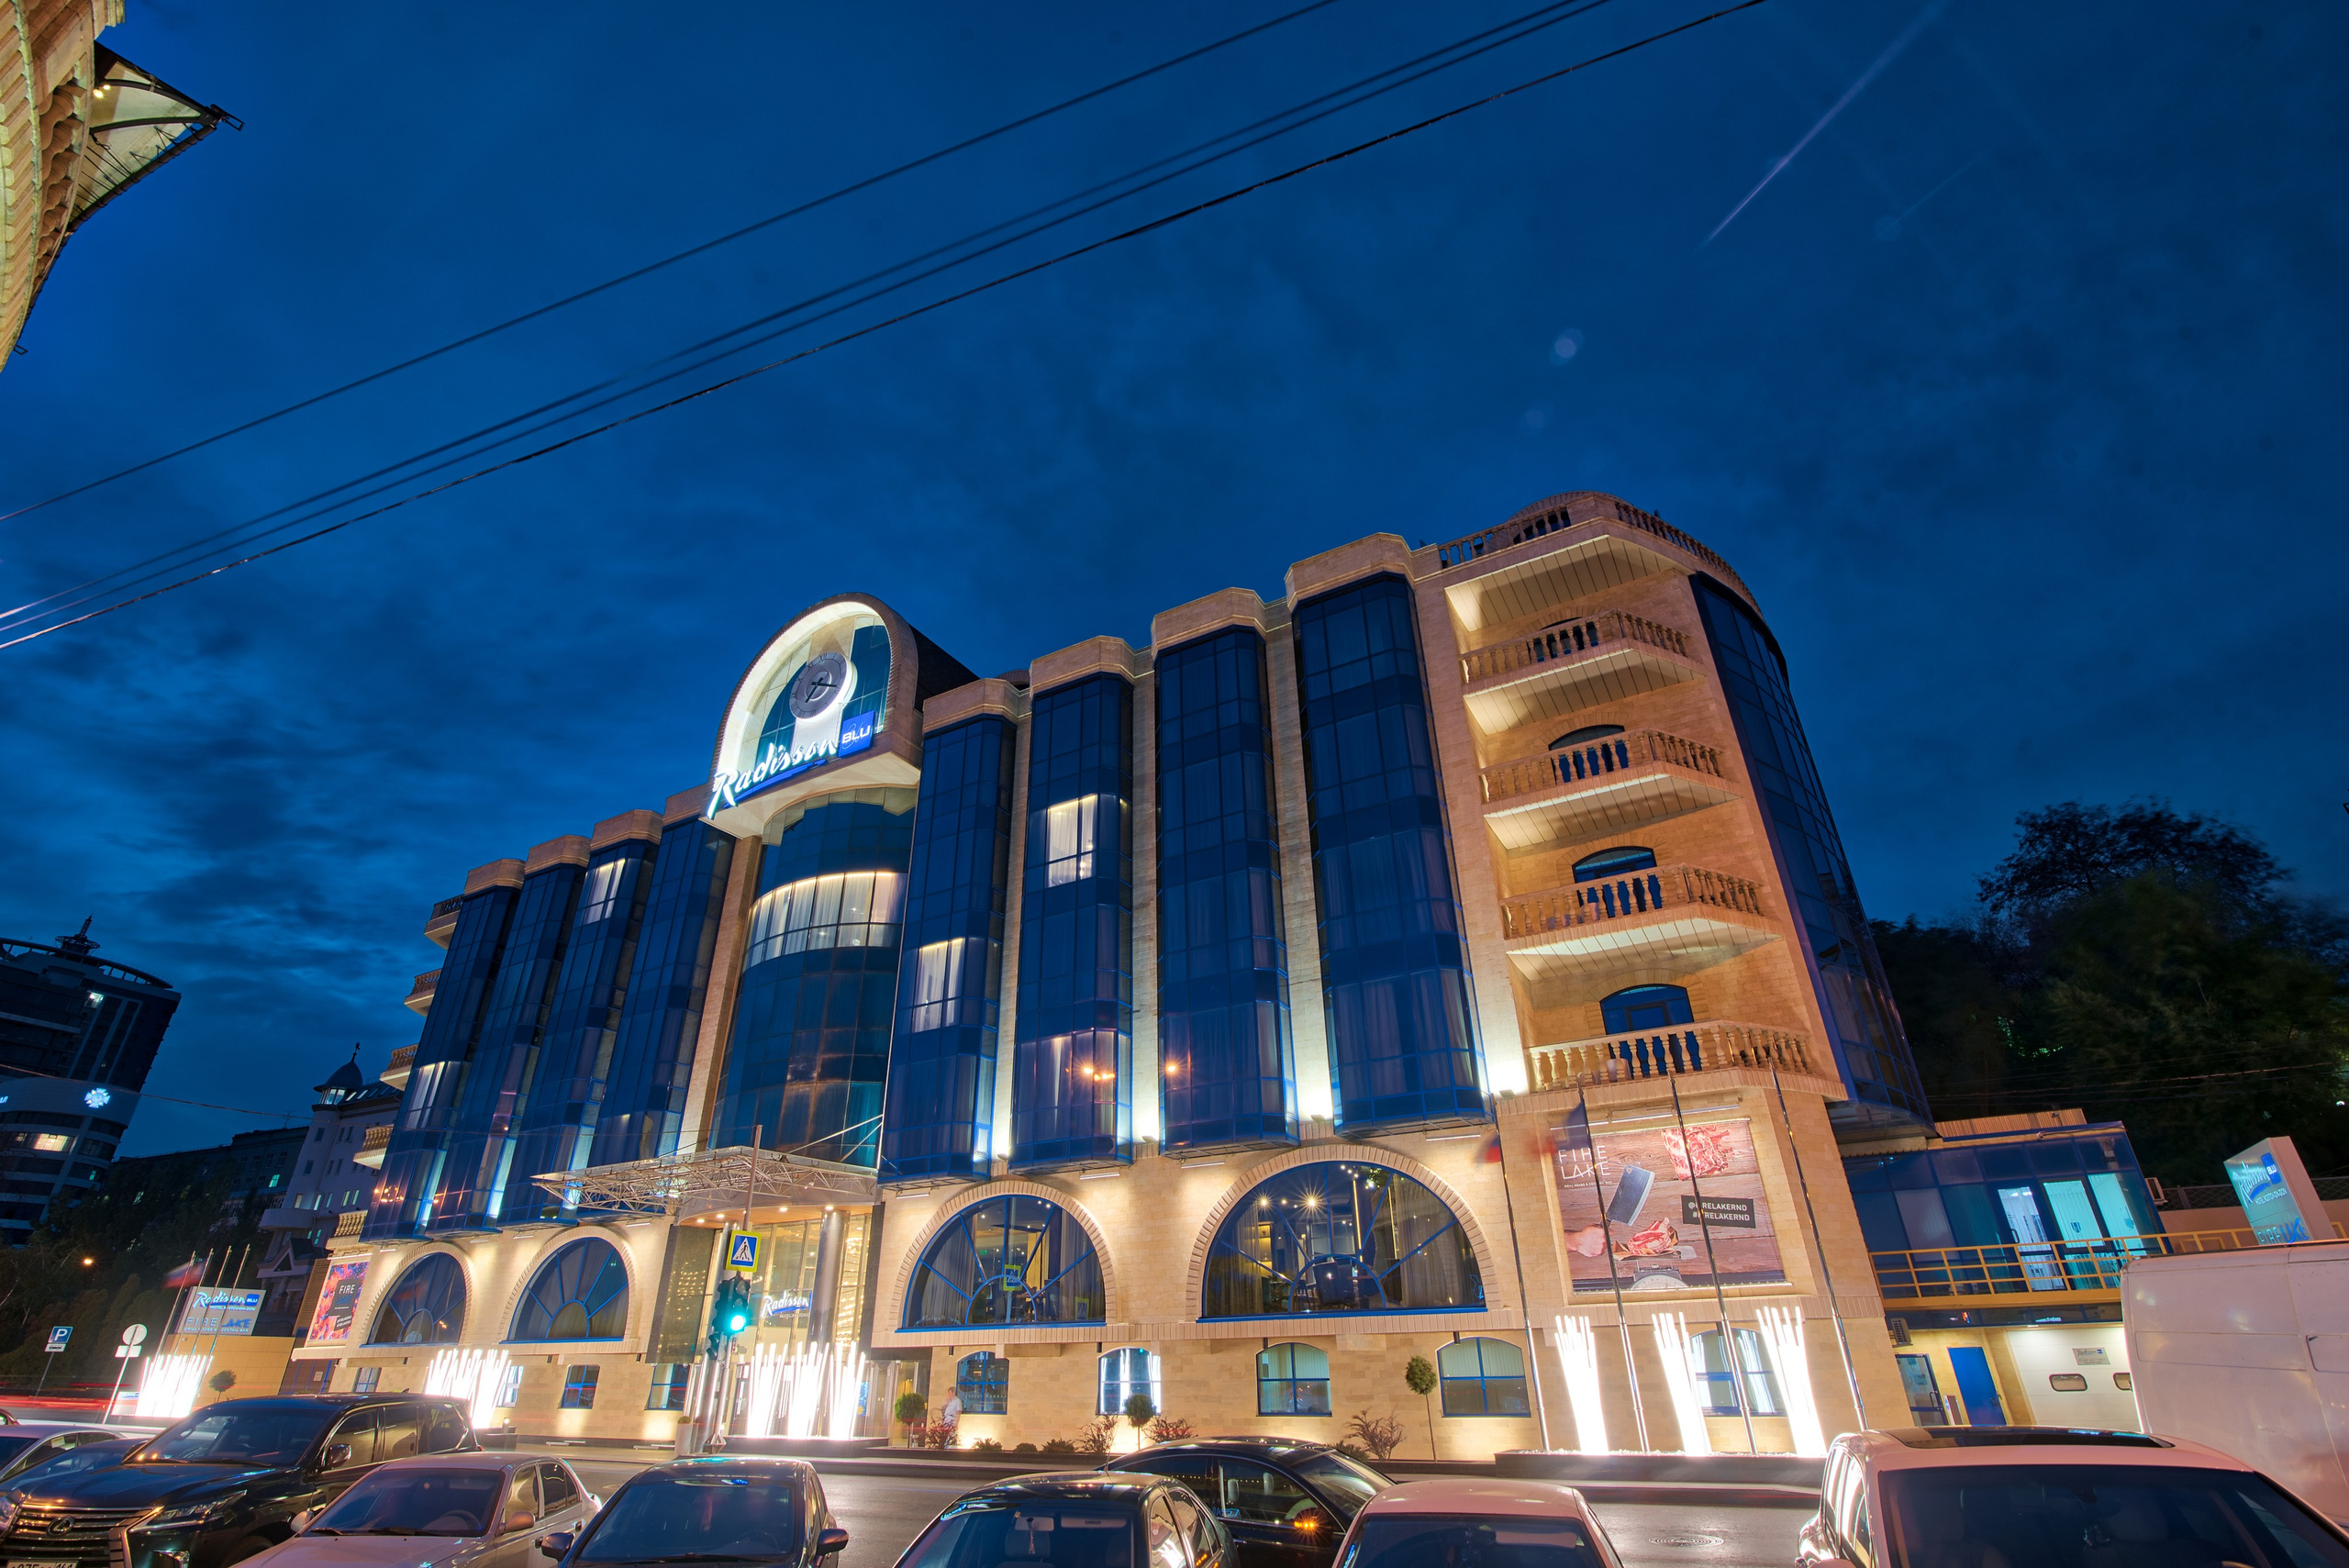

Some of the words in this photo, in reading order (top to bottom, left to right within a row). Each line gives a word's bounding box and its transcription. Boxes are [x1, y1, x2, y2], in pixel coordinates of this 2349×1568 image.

[707, 739, 839, 819] Radisson
[841, 724, 871, 744] BLU
[1558, 1145, 1608, 1163] FIRE
[1561, 1161, 1611, 1180] LAKE
[2232, 1162, 2270, 1209] Radisson
[2266, 1164, 2277, 1174] BLU
[339, 1284, 355, 1294] FIRE
[762, 1290, 808, 1318] Radisson
[185, 1318, 217, 1327] FIRE
[221, 1318, 251, 1328] AKE
[54, 1329, 68, 1341] P
